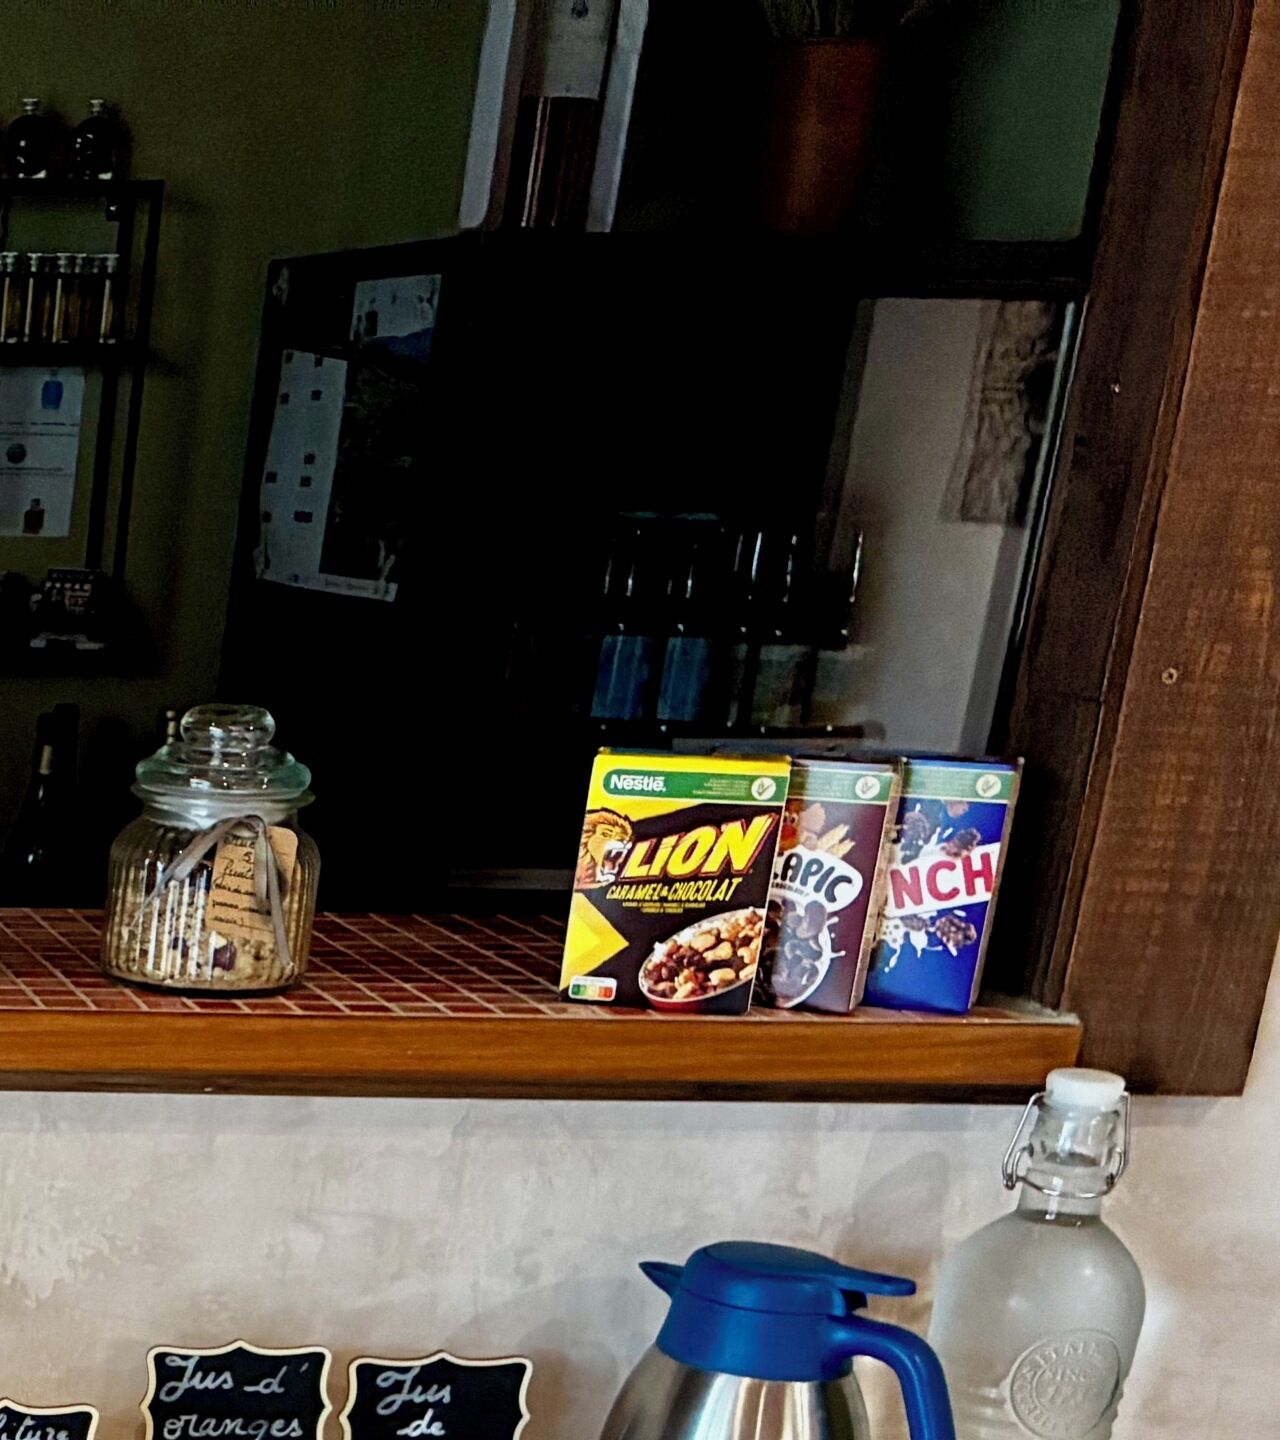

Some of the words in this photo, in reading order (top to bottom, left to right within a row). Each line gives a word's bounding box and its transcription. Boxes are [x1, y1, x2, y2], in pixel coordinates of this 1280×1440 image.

[610, 773, 666, 792] Nestlé
[620, 813, 778, 880] LION
[668, 877, 743, 901] CHOCOLAT
[773, 852, 853, 904] APIC
[889, 852, 994, 910] NCH
[159, 1354, 234, 1402] Jus
[375, 1366, 452, 1416] Jus
[396, 1407, 446, 1437] de
